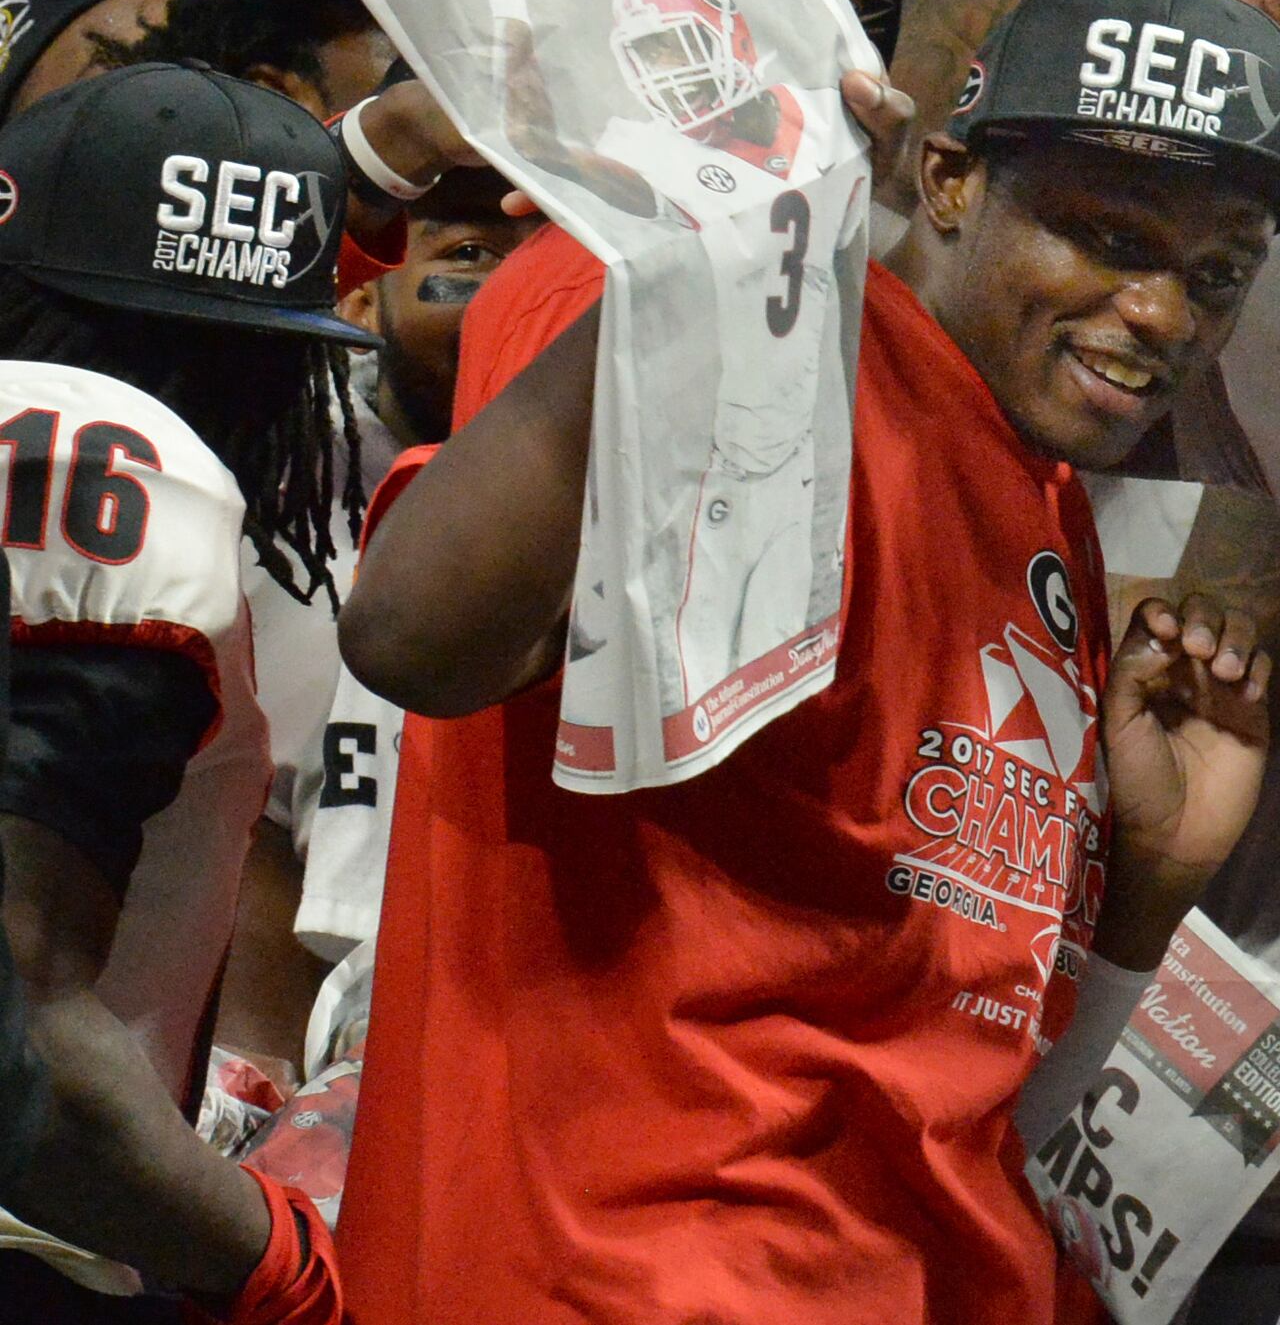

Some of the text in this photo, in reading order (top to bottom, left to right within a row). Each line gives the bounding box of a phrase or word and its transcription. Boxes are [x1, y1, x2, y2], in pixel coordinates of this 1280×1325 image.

[1079, 18, 1231, 114] SEC
[1077, 87, 1099, 116] 017
[1096, 89, 1222, 137] CHAMPS
[156, 154, 300, 249] SEC
[152, 231, 178, 270] 2017
[176, 233, 291, 288] CHAMPS
[766, 189, 810, 338] 3
[0, 407, 163, 566] 16
[918, 729, 995, 775] 2017
[1003, 760, 1050, 805] SEC
[886, 865, 998, 930] GEORGIA
[952, 991, 1026, 1029] IT JUST
[1163, 953, 1248, 1035] onstitution
